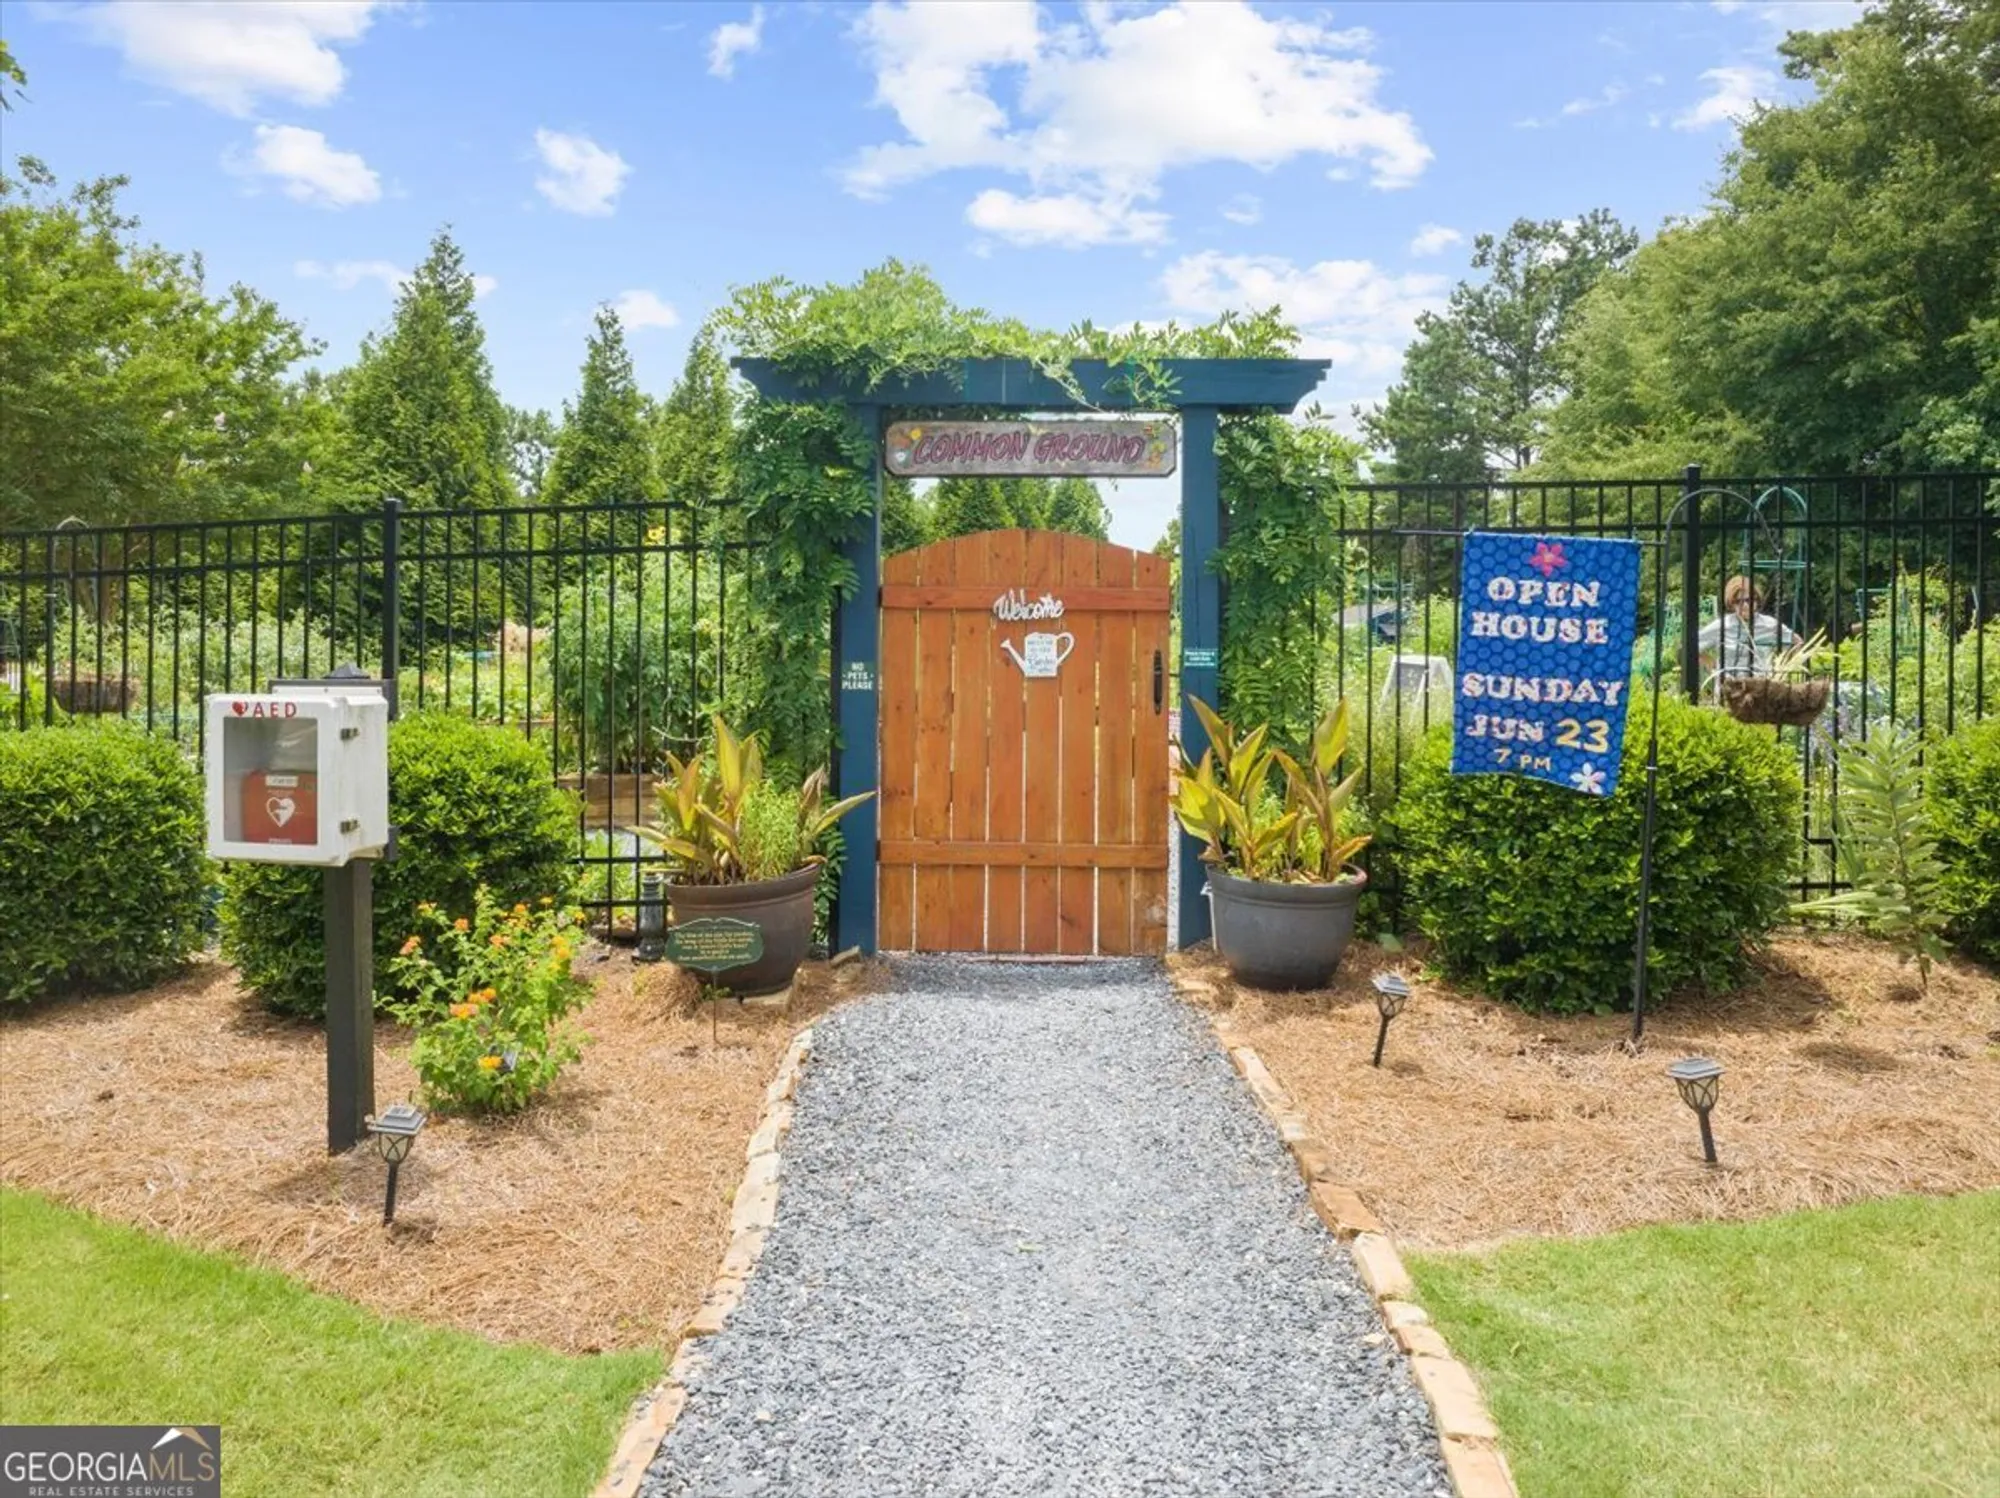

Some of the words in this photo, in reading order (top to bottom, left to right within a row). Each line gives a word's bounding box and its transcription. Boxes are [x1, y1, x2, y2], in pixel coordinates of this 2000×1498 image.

[913, 431, 1030, 464] COMMON
[1033, 432, 1146, 464] GROUND
[993, 588, 1065, 620] Welcome
[1487, 577, 1601, 607] OPEN
[1471, 611, 1609, 644] HOUSE
[851, 661, 865, 671] NO
[841, 680, 873, 690] PLEASE
[1462, 672, 1624, 706] SUNDAY
[252, 702, 298, 718] AED
[1465, 714, 1545, 742] JUN
[1555, 718, 1610, 754] 23
[1493, 748, 1512, 763] 7
[1519, 754, 1551, 771] PM
